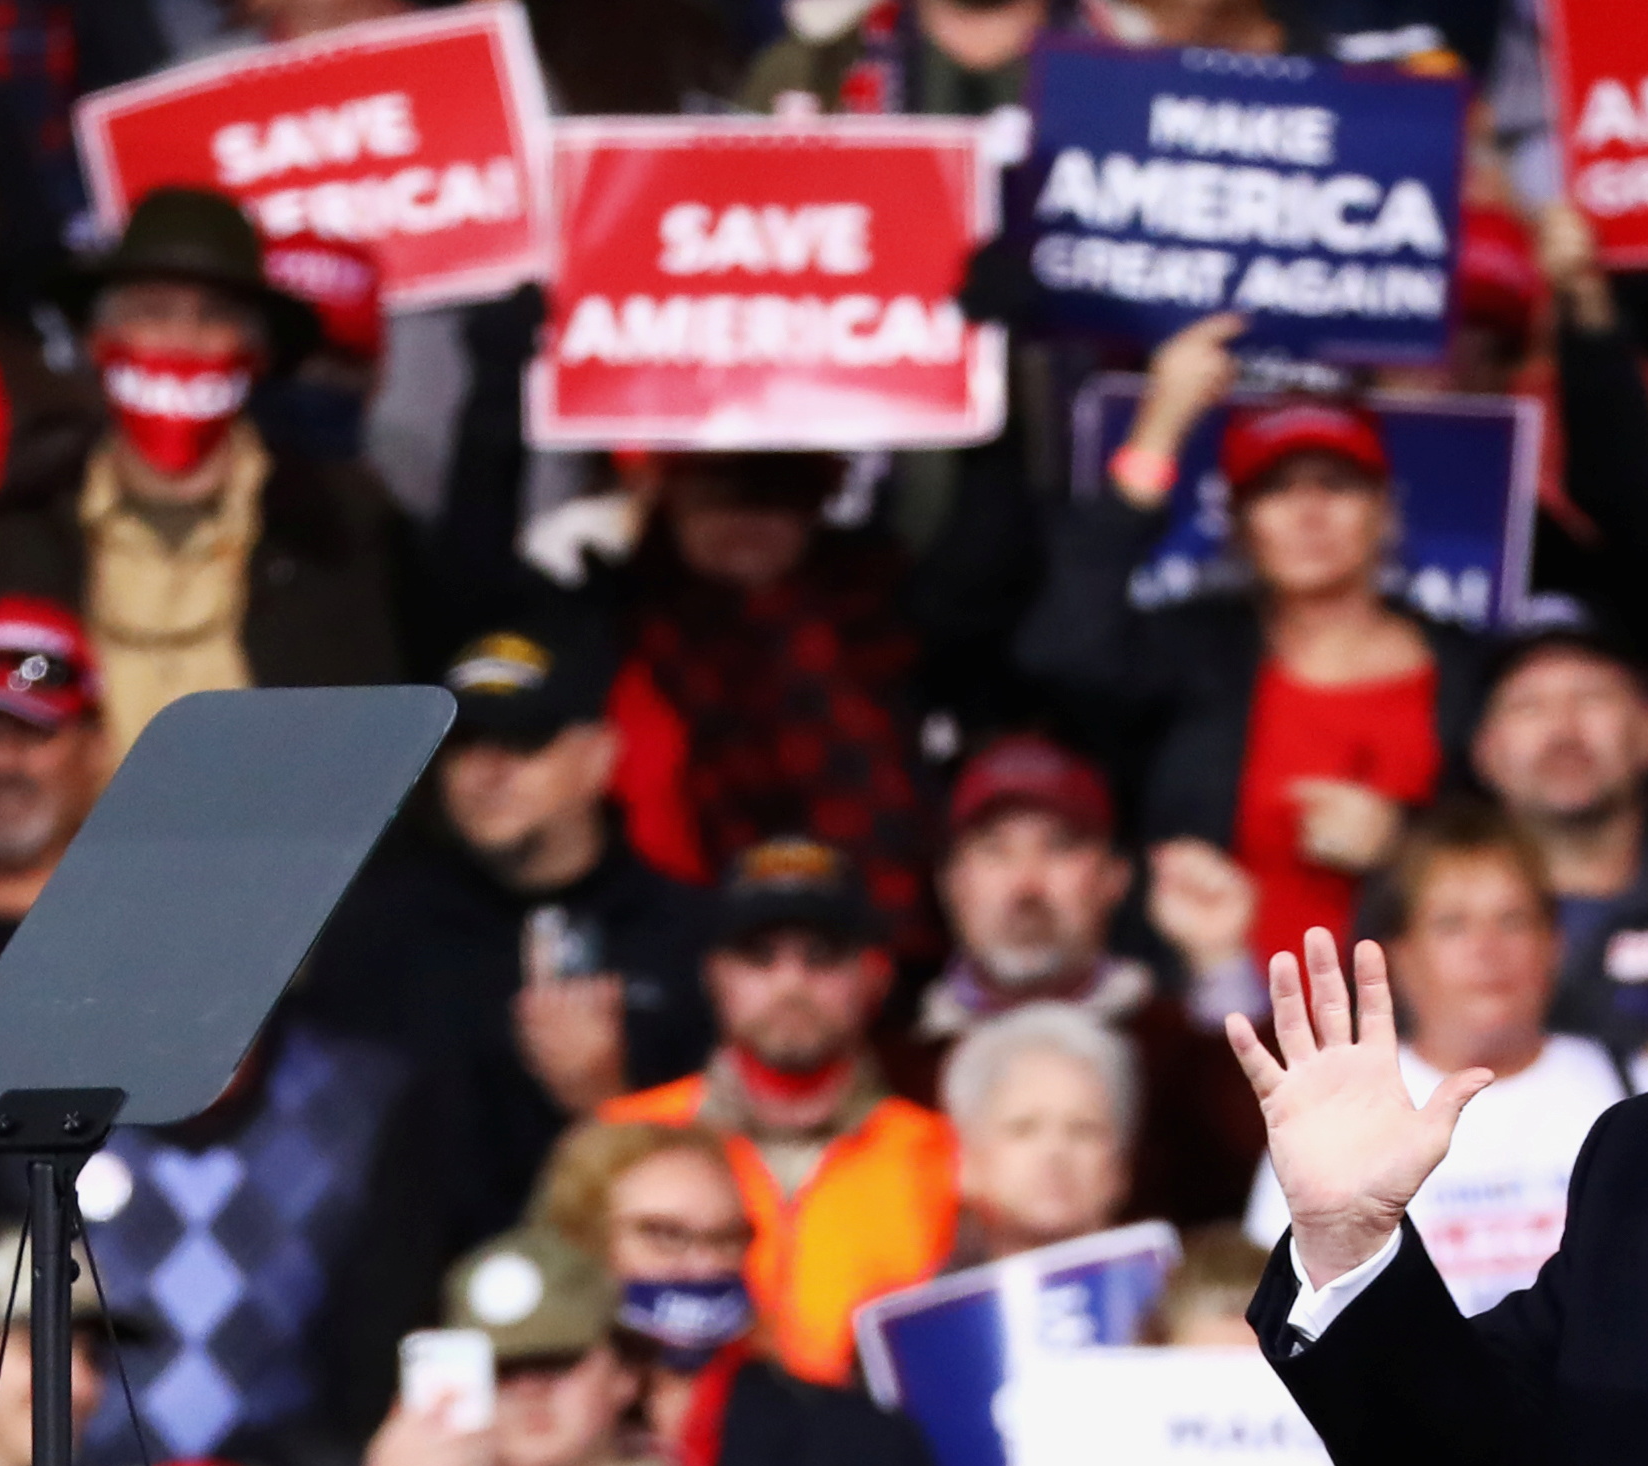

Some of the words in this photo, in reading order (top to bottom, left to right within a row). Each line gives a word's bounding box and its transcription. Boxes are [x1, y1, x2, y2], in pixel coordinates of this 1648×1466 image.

[211, 90, 421, 186] SAVE
[1148, 94, 1339, 165] MAKE
[659, 202, 873, 275] SAVE
[1032, 147, 1449, 256] AMERICA
[1031, 235, 1232, 308] GREAT
[1232, 256, 1449, 321] AGAIN
[561, 295, 963, 367] AMERICA!
